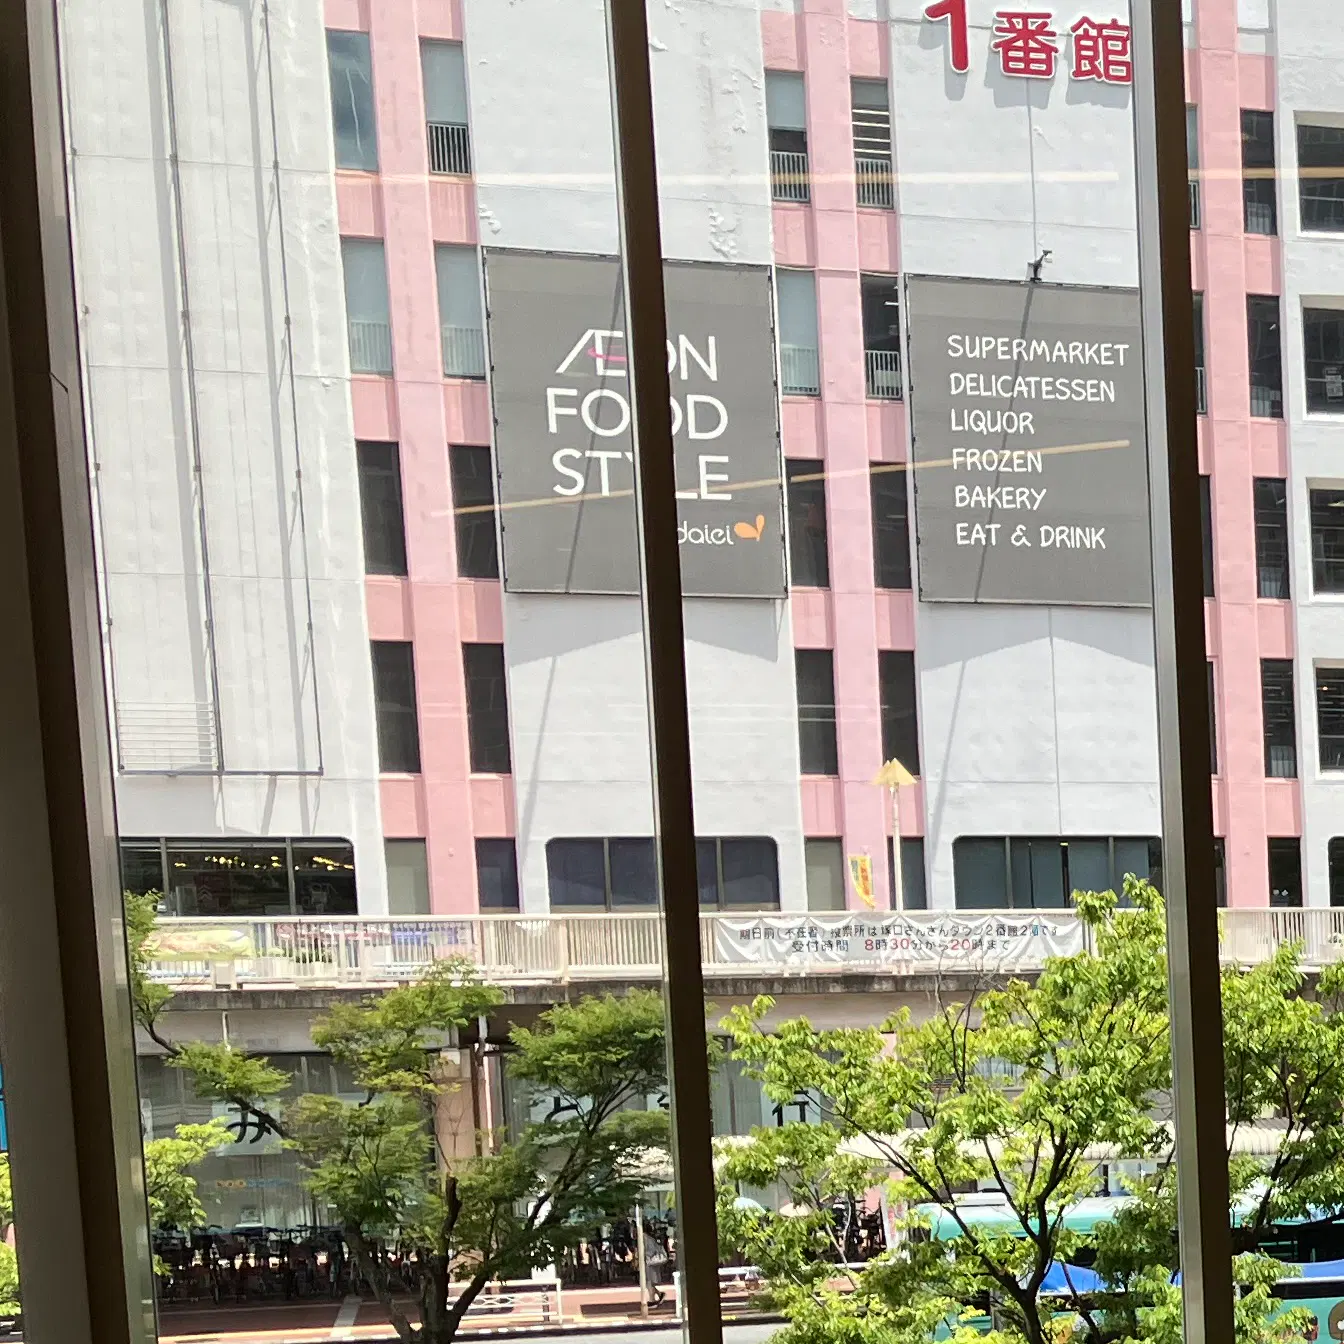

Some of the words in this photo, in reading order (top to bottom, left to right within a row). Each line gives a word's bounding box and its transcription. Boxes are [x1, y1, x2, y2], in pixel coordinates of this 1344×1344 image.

[924, 0, 1132, 84] 1番館
[947, 335, 1130, 366] SUPERMARKET
[949, 372, 1115, 402] DELICATESSEN
[951, 408, 1035, 435] LIQUOR
[952, 448, 1043, 473] FROZEN
[954, 485, 1047, 511] BAKERY
[677, 520, 734, 545] daiei
[956, 522, 1001, 546] EAT
[1010, 524, 1031, 547] &
[1039, 525, 1106, 549] DRINK
